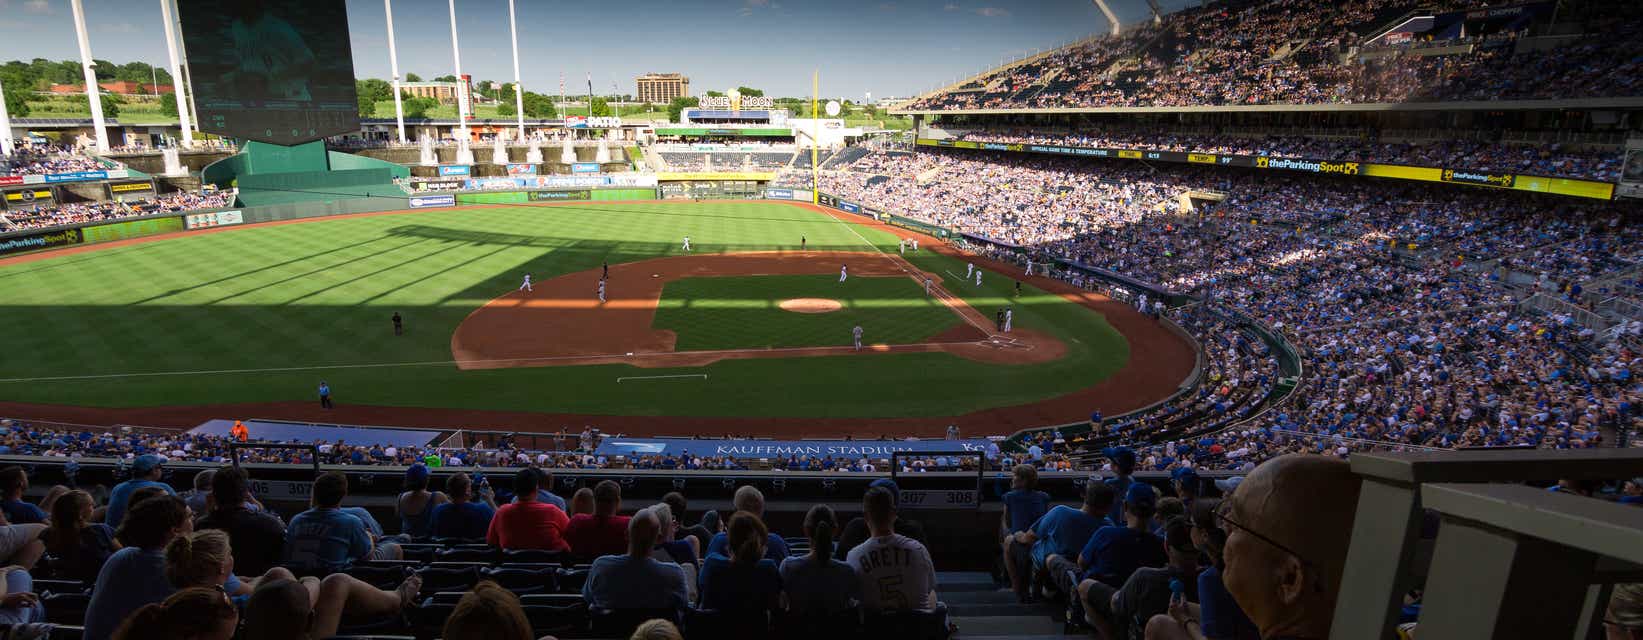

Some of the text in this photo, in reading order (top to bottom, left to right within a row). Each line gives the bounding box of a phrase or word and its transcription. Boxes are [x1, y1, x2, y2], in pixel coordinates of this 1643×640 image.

[699, 94, 773, 108] BLUE MOON
[587, 116, 621, 128] PATIO
[1269, 158, 1344, 173] theParkingSpot
[0, 233, 66, 250] heParkingSpot
[717, 446, 820, 454] KAUFFMAN
[288, 482, 312, 495] 307
[860, 546, 912, 573] BRETT
[879, 575, 908, 609] 5
